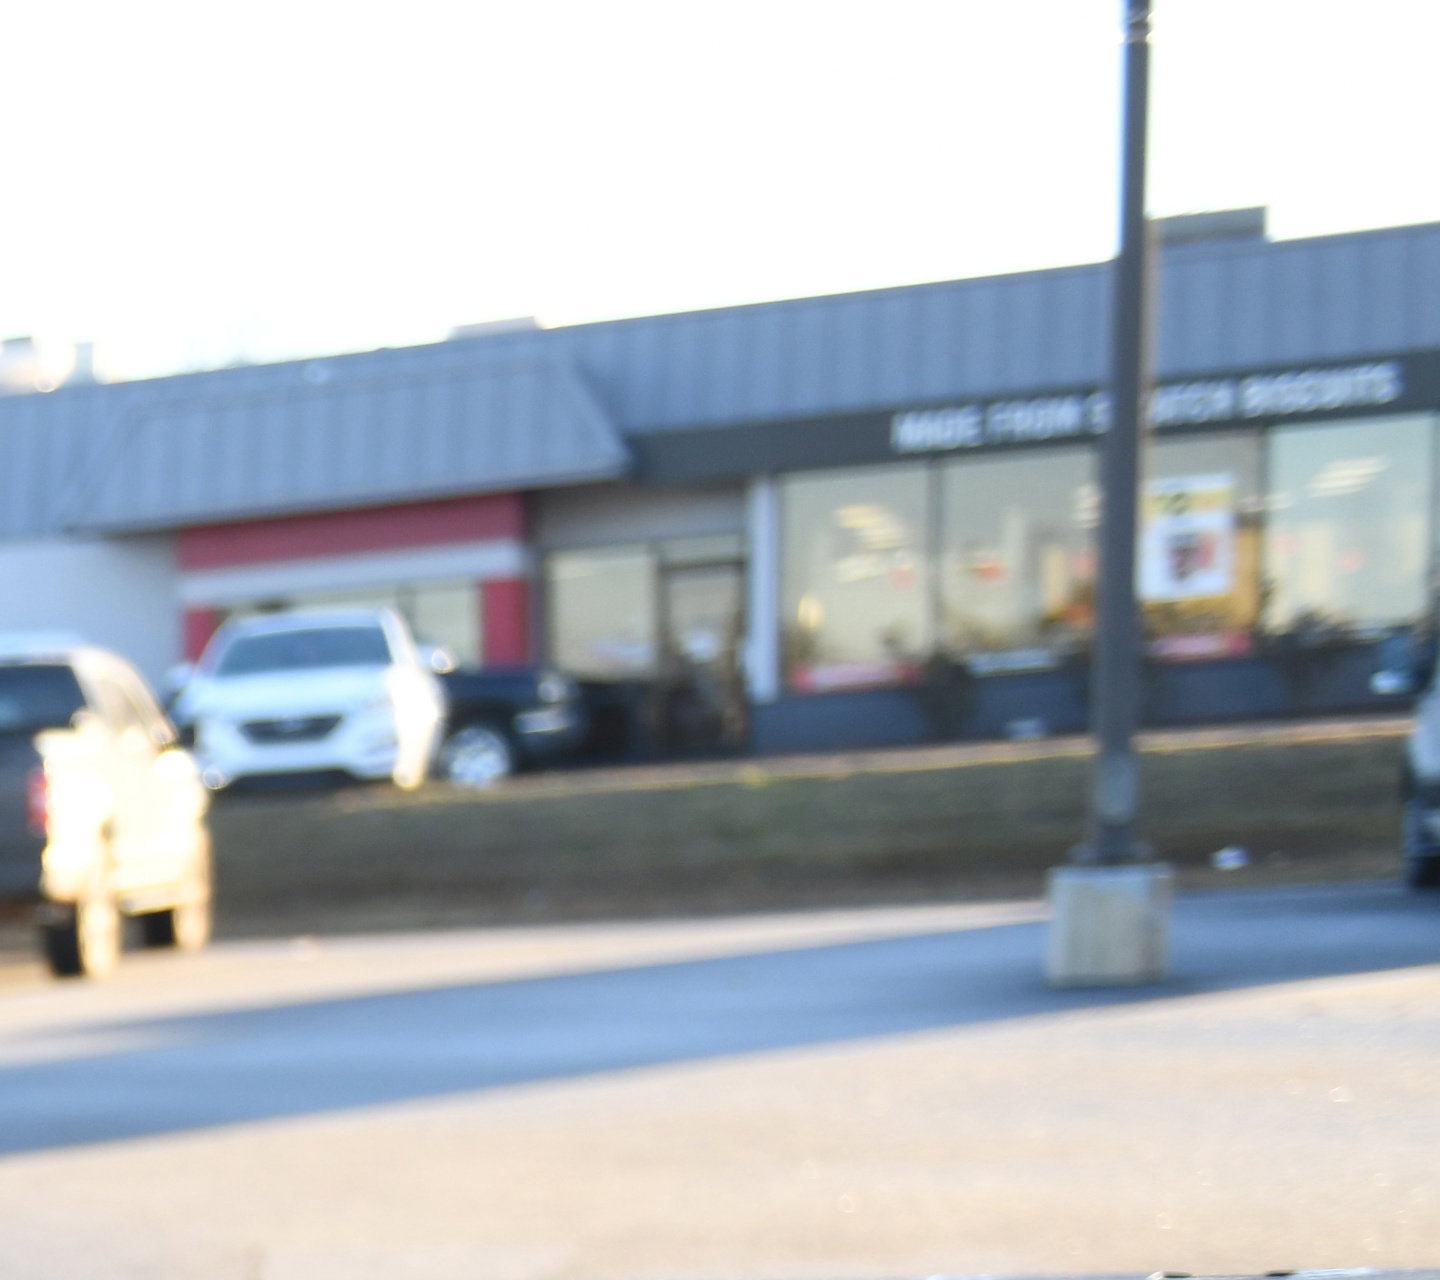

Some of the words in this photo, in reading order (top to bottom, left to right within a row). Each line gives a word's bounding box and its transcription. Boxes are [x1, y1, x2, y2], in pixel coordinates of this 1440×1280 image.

[892, 405, 982, 453] MADE
[988, 396, 1081, 445] FROM
[1241, 363, 1400, 415] BISCUITS
